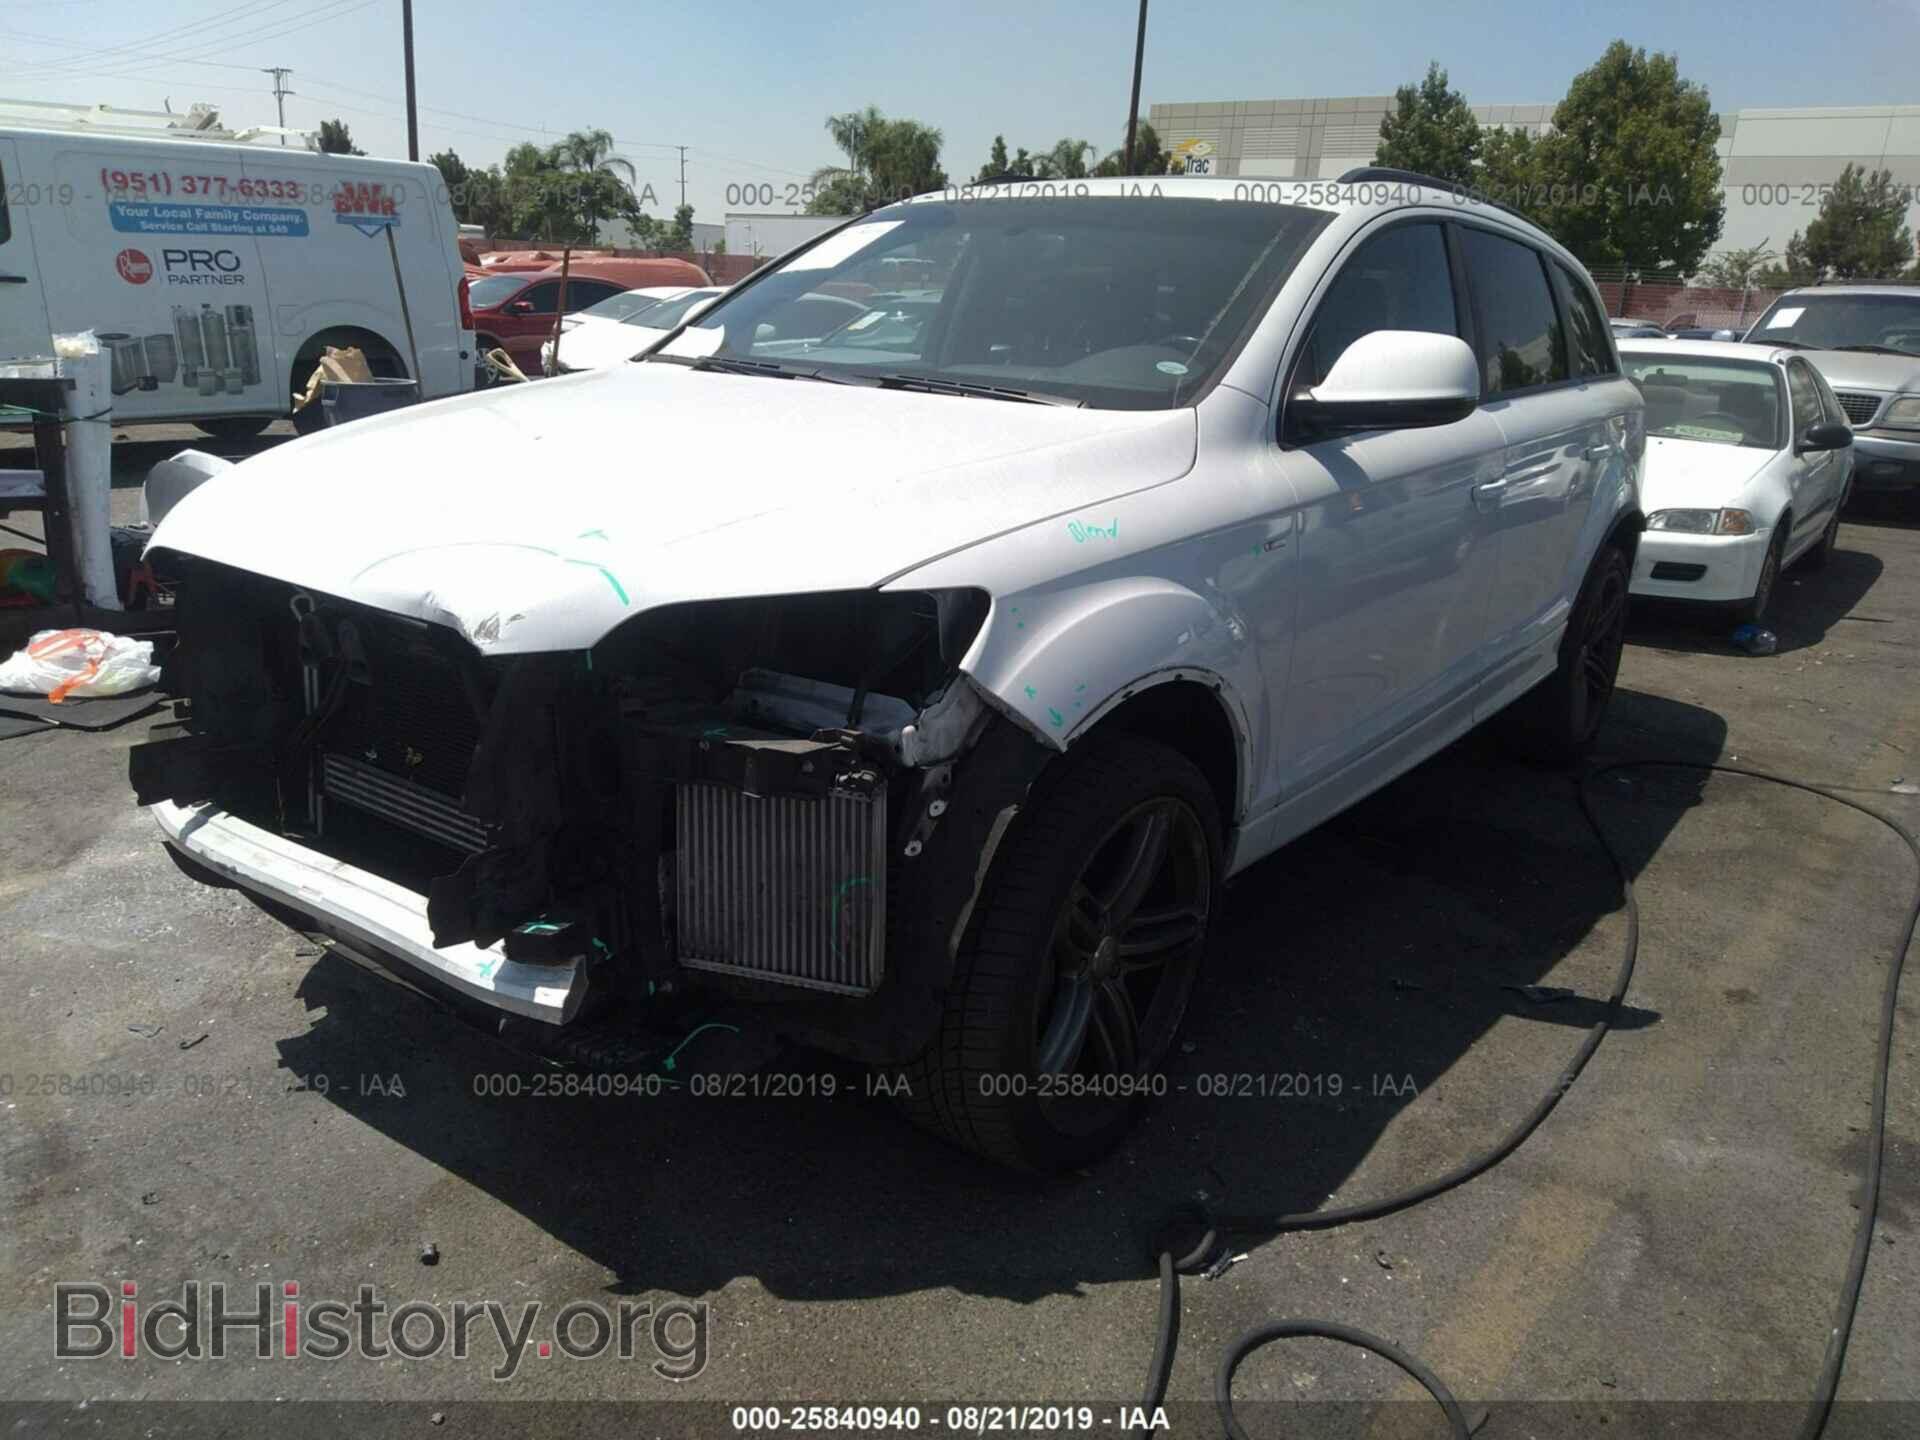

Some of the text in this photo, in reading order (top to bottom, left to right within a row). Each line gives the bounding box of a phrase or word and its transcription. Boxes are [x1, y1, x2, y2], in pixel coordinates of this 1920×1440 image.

[101, 167, 300, 199] (951) 377-6333
[117, 205, 149, 217] Your
[153, 206, 192, 219] Local
[195, 207, 240, 222] Family
[140, 221, 184, 232] Service
[186, 222, 208, 233] Call
[211, 222, 254, 235] Starting
[256, 223, 266, 233] at
[162, 249, 241, 272] PRO
[167, 274, 245, 285] PARTNER
